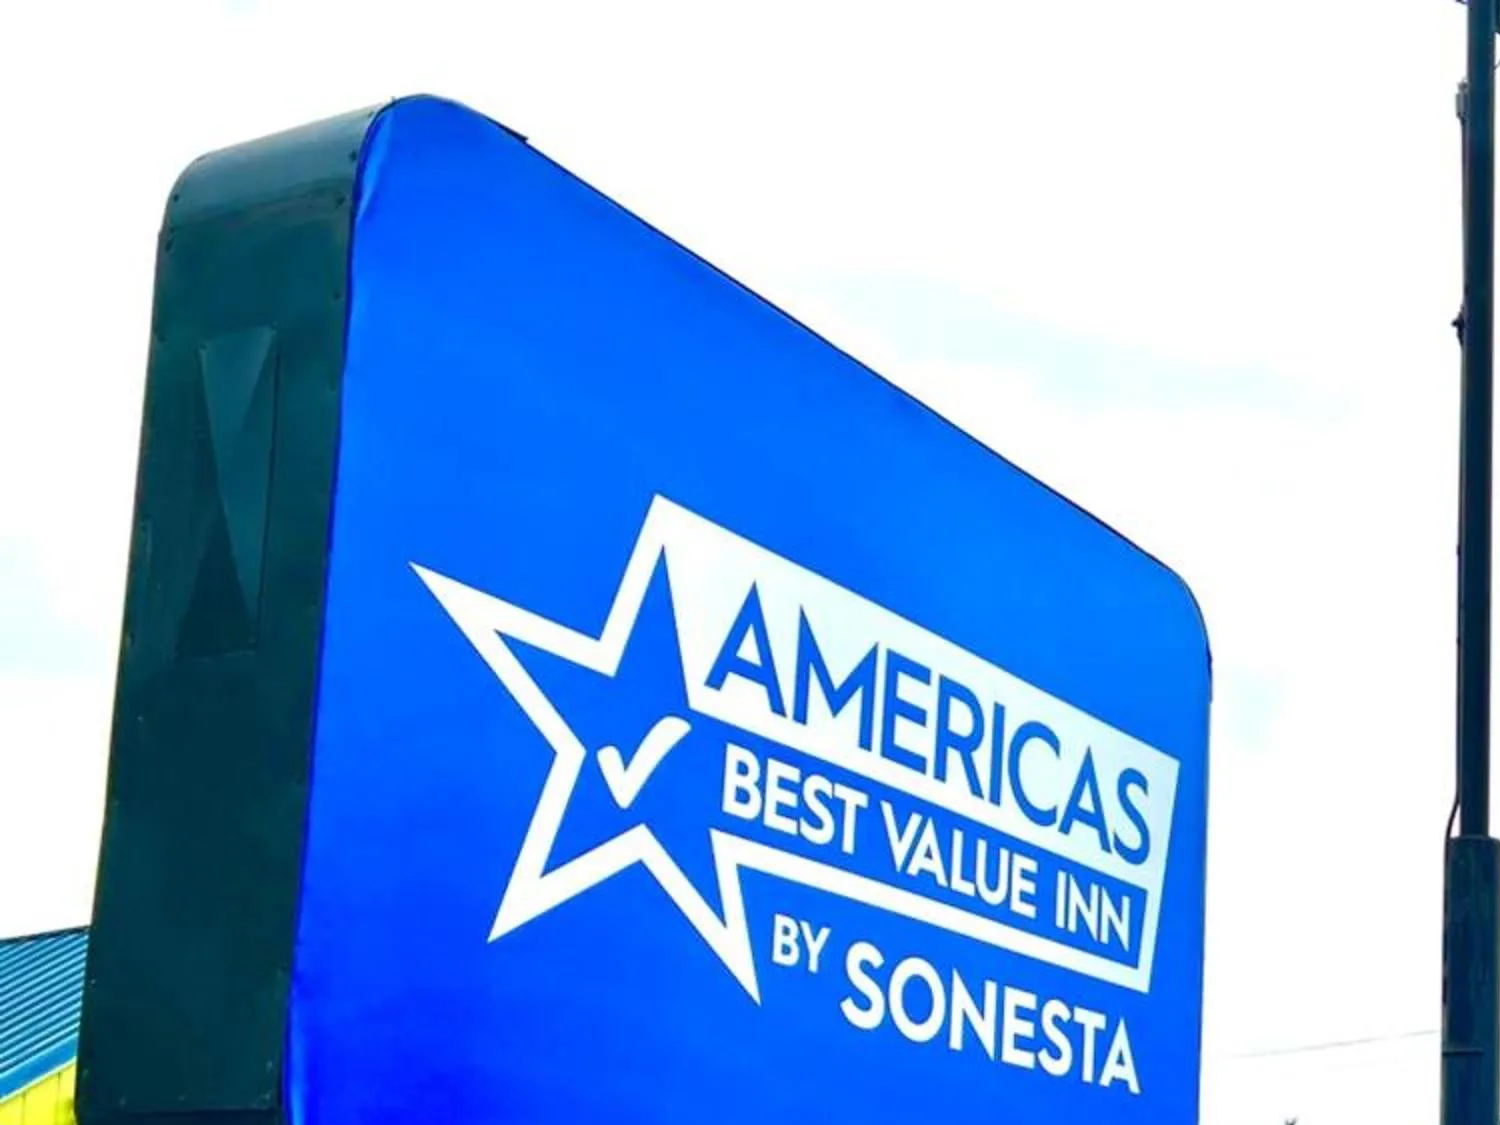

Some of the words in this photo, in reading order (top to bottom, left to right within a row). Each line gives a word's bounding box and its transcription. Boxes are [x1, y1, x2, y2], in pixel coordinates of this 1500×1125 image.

[703, 579, 1150, 865] AMERICAS
[721, 742, 868, 854] BEST
[880, 800, 1038, 918] VALUE
[1055, 869, 1131, 952] INN
[771, 912, 831, 974] BY
[840, 941, 1141, 1095] SONESTA
